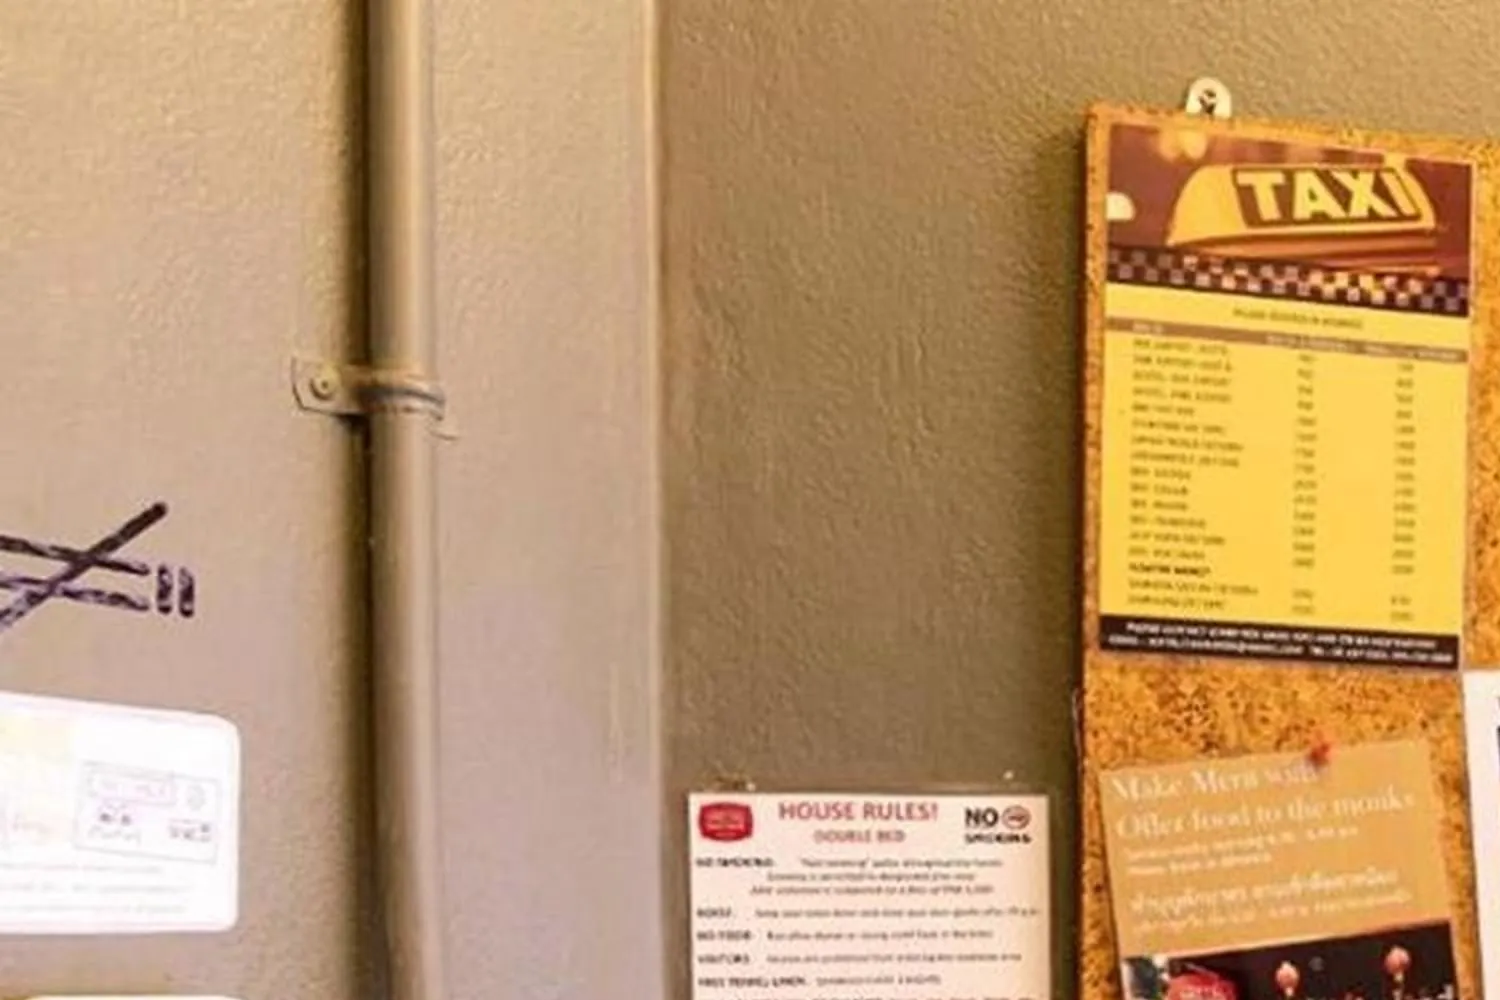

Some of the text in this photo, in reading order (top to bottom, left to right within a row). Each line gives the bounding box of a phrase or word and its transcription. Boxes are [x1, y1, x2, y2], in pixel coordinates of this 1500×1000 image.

[1235, 169, 1418, 222] TAXI
[1112, 776, 1182, 801] Make
[778, 802, 939, 821] HOUSE RULES!
[964, 807, 999, 828] NO
[1116, 812, 1185, 838] Offer
[1256, 806, 1281, 824] to
[1288, 799, 1325, 819] the
[1333, 784, 1415, 816] monks
[813, 830, 906, 843] DOUBLE BED
[964, 833, 1033, 844] SMOKING
